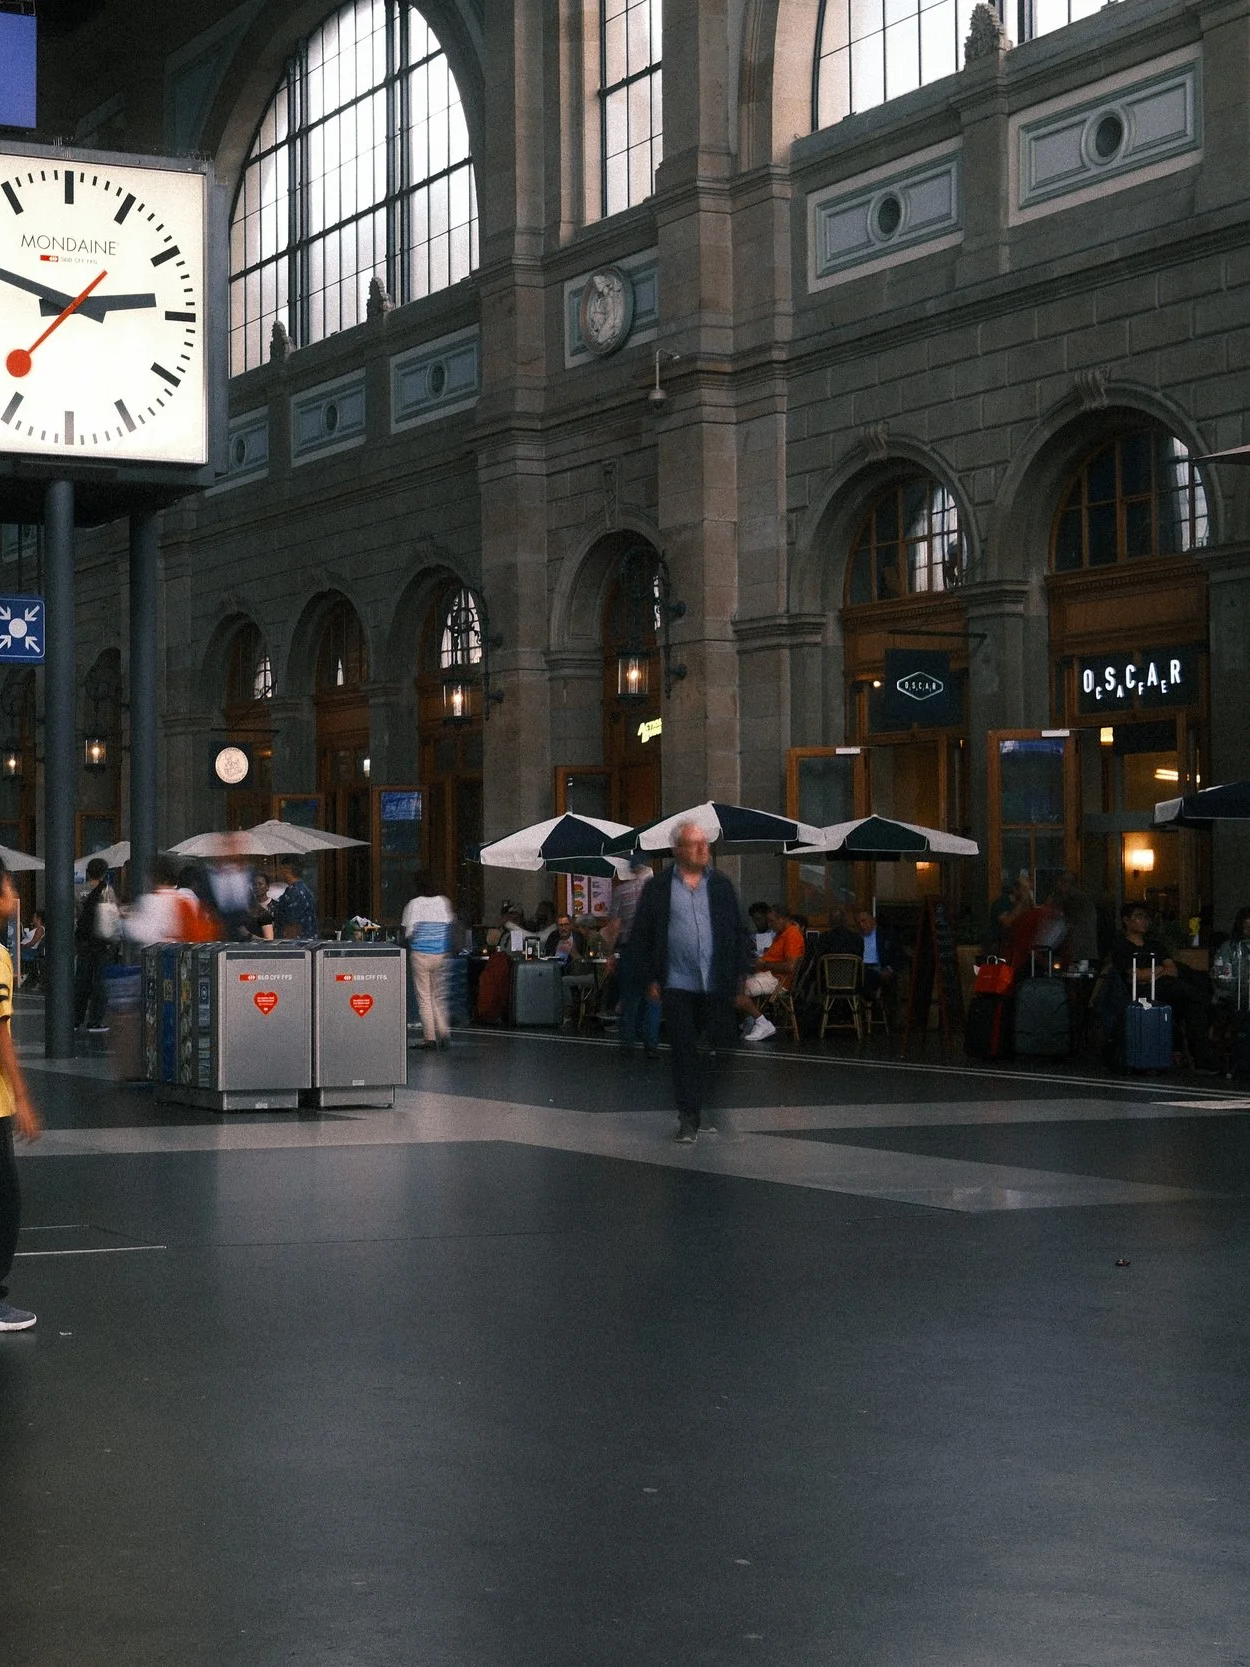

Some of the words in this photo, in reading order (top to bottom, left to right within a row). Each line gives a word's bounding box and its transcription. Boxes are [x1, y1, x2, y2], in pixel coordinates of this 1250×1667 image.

[21, 234, 117, 256] MONDAINE
[904, 681, 937, 690] OSCAR
[1083, 659, 1182, 693] OSCAR
[1095, 680, 1169, 700] CAFE
